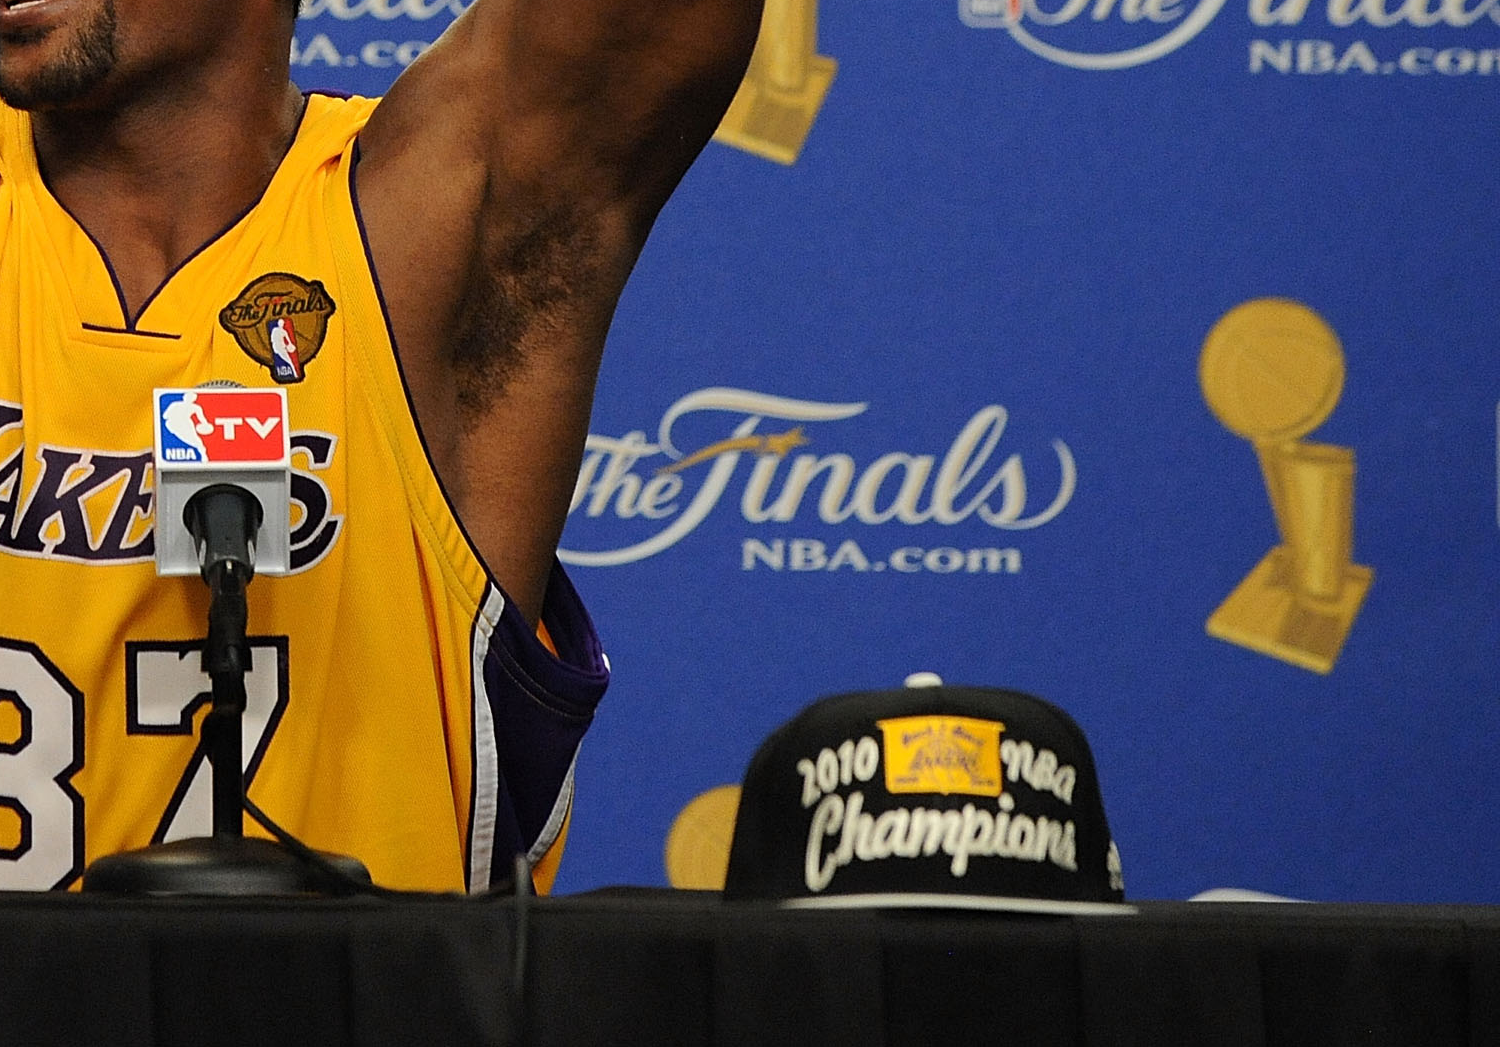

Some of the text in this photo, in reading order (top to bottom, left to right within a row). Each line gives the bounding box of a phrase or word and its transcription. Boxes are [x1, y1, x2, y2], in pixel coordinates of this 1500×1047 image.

[253, 286, 328, 324] Finals
[214, 416, 281, 441] TV
[165, 447, 197, 461] NBA
[658, 386, 1077, 565] Finals
[741, 539, 1023, 573] NBA.com
[796, 735, 880, 809] 2010
[803, 790, 1079, 893] Champions
